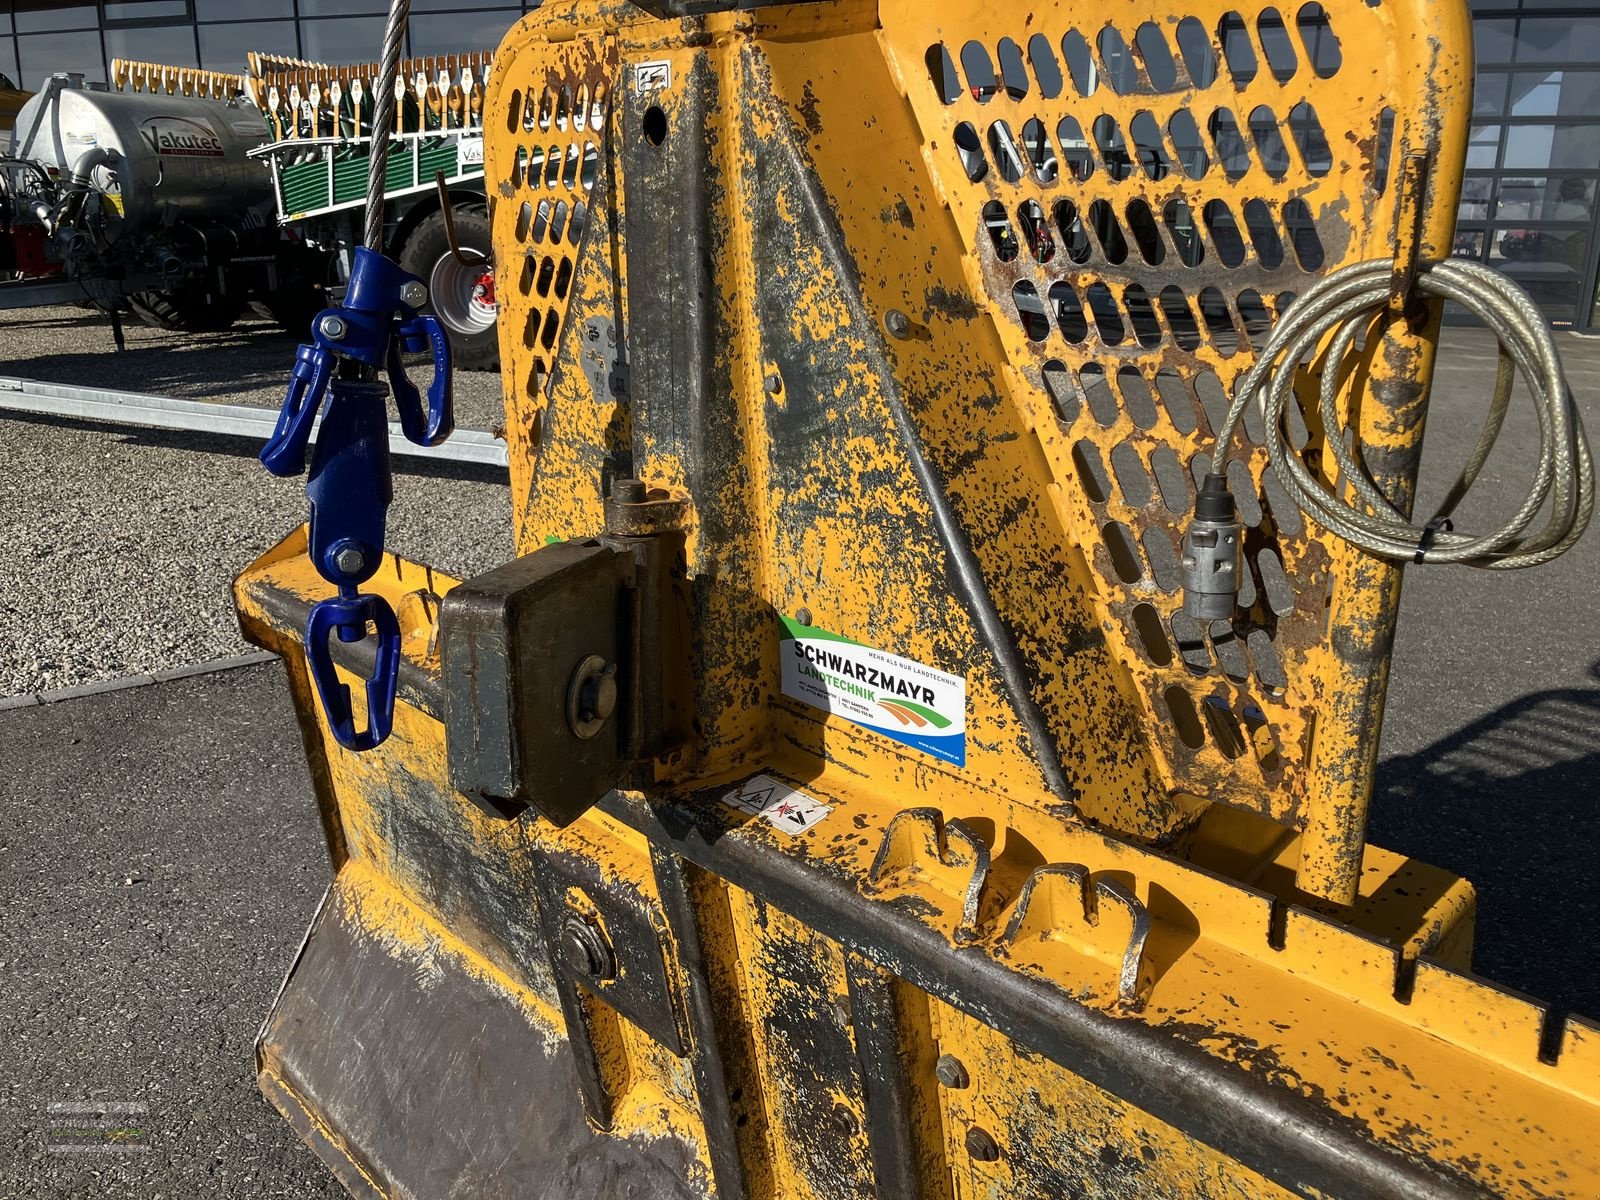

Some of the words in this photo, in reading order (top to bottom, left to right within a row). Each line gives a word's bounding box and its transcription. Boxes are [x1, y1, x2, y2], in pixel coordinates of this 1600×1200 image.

[141, 126, 222, 154] Vakutec
[794, 640, 935, 707] SCHWARZMAYR
[868, 651, 885, 663] MEHR
[886, 656, 898, 667] ALS
[899, 661, 912, 672] NUR
[798, 662, 875, 702] LANDTECHNIK
